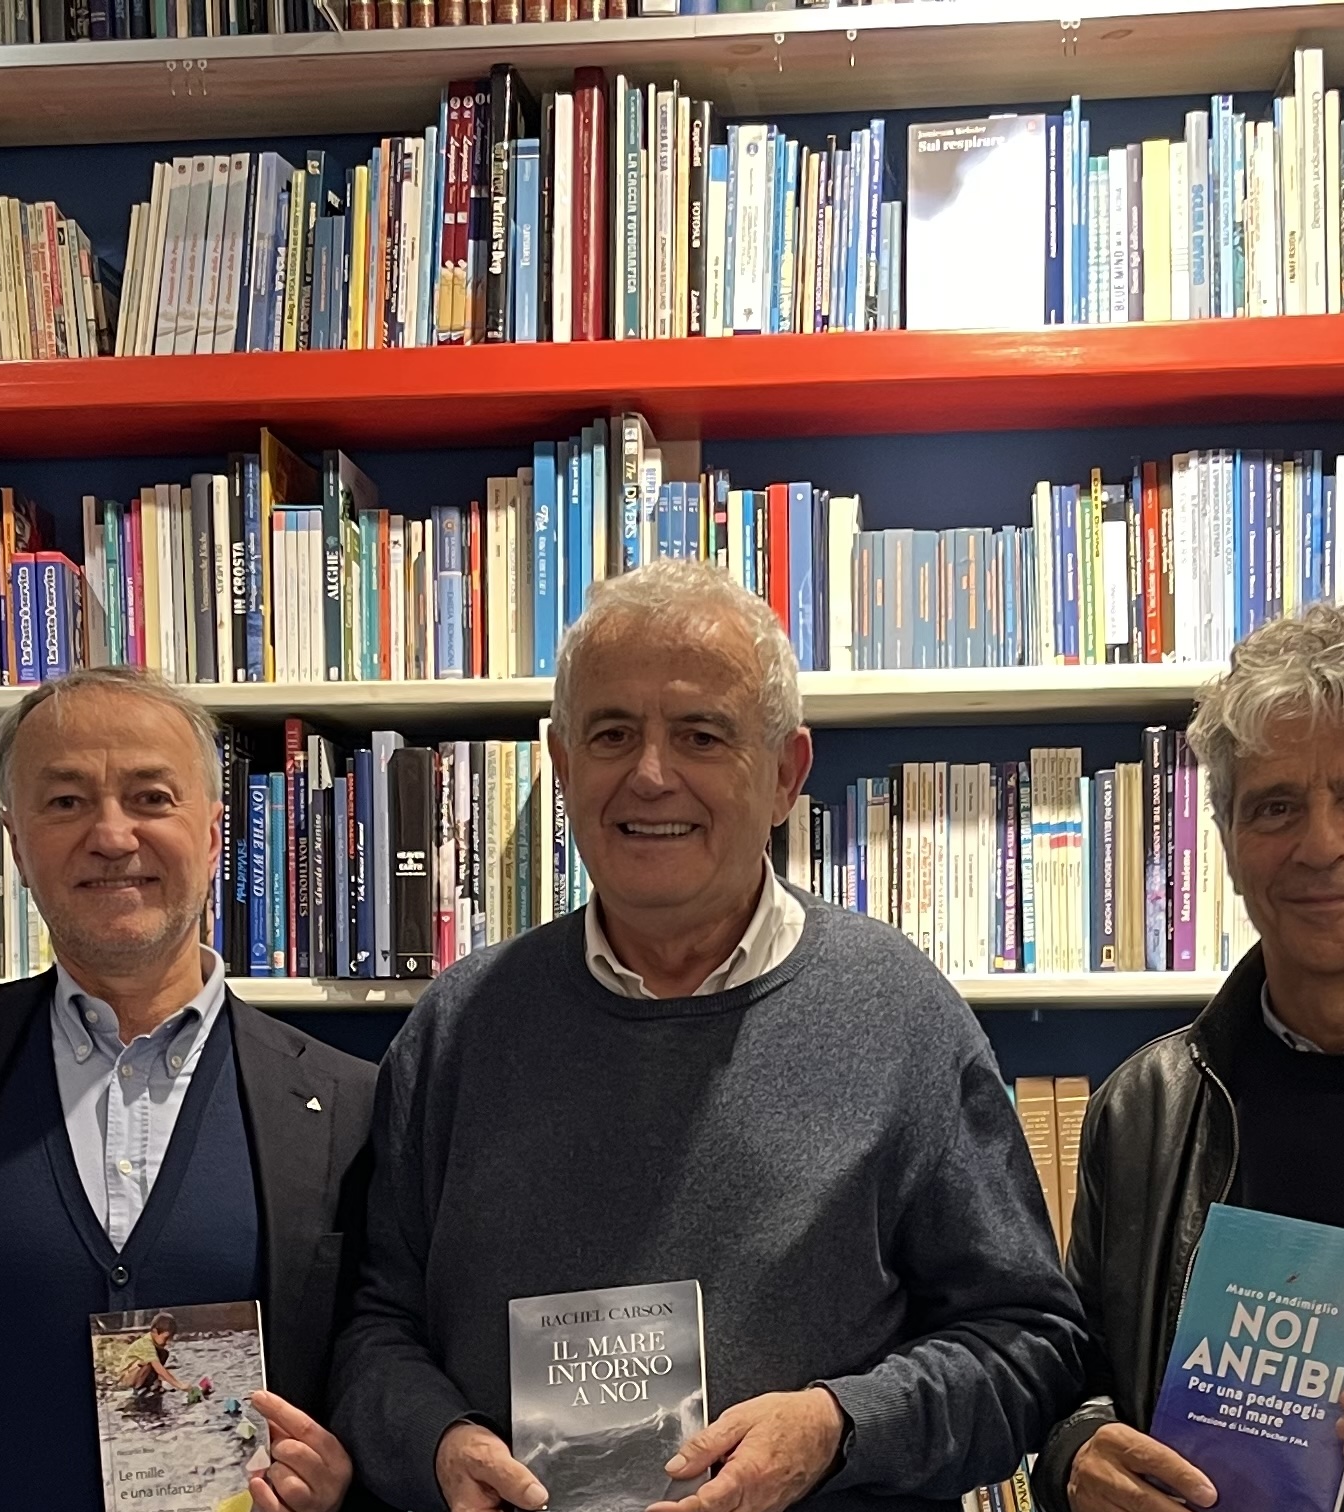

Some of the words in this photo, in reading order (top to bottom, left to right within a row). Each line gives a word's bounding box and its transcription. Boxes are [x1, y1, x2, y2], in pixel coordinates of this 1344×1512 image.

[918, 139, 940, 152] Sul
[943, 135, 1005, 151] respirare
[627, 153, 638, 168] LA
[627, 171, 638, 212] CACCIA
[627, 215, 638, 293] FOTOGRAFICA
[624, 460, 637, 479] The
[624, 486, 638, 538] DIVERS
[44, 565, 58, 601] servita
[231, 542, 246, 598] CROSTA
[325, 551, 340, 600] ALGHE
[19, 568, 33, 602] servita
[21, 606, 34, 616] è
[45, 605, 58, 615] è
[231, 601, 246, 614] IN
[19, 619, 34, 648] Pasta
[44, 618, 58, 648] Pasta
[20, 650, 34, 665] La
[44, 649, 58, 666] La
[252, 790, 265, 813] ON
[252, 817, 265, 849] THE
[395, 850, 426, 860] HEAVEN
[397, 863, 425, 872] EARTH
[236, 838, 249, 903] MALDIMARE
[252, 852, 264, 898] WIND
[298, 836, 309, 917] BOATHOUSES
[1226, 1283, 1263, 1302] Mauro
[1267, 1291, 1339, 1317] Pandimiglio
[541, 1309, 605, 1328] RACHEL
[608, 1302, 674, 1321] CARSON
[1229, 1302, 1319, 1355] NOI
[552, 1340, 578, 1361] IL
[588, 1331, 665, 1357] MARE
[547, 1355, 673, 1386] INTORNO
[571, 1389, 589, 1407] A
[600, 1381, 649, 1404] NOI
[1188, 1376, 1213, 1395] Per
[1216, 1385, 1243, 1402] una
[1246, 1391, 1326, 1421] pedagogia
[1219, 1404, 1242, 1420] nel
[1245, 1410, 1284, 1428] mare
[119, 1469, 132, 1481] Le
[135, 1467, 165, 1481] mille
[130, 1489, 154, 1498] una
[155, 1483, 203, 1497] infanzia
